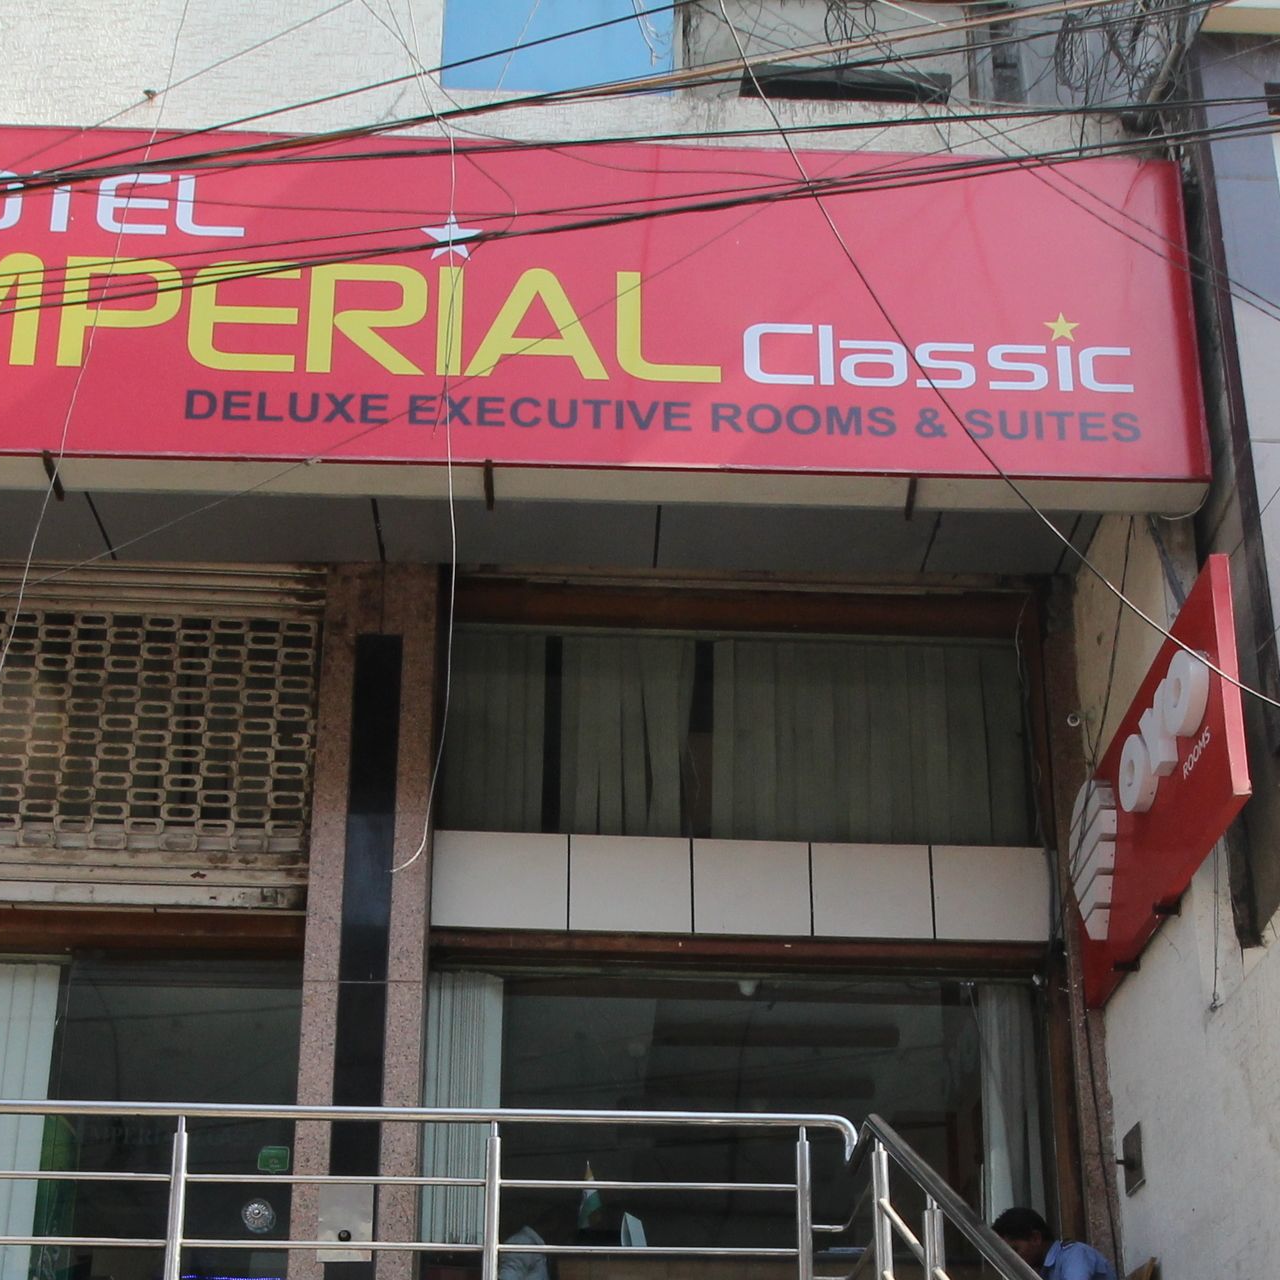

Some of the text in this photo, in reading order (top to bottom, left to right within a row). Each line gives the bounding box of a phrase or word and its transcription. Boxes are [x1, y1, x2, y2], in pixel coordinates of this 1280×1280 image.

[742, 313, 1135, 393] Classic
[184, 389, 1143, 444] DELUXE EXECUTIVE ROOMS & SUITES
[1181, 725, 1212, 781] ROOMS
